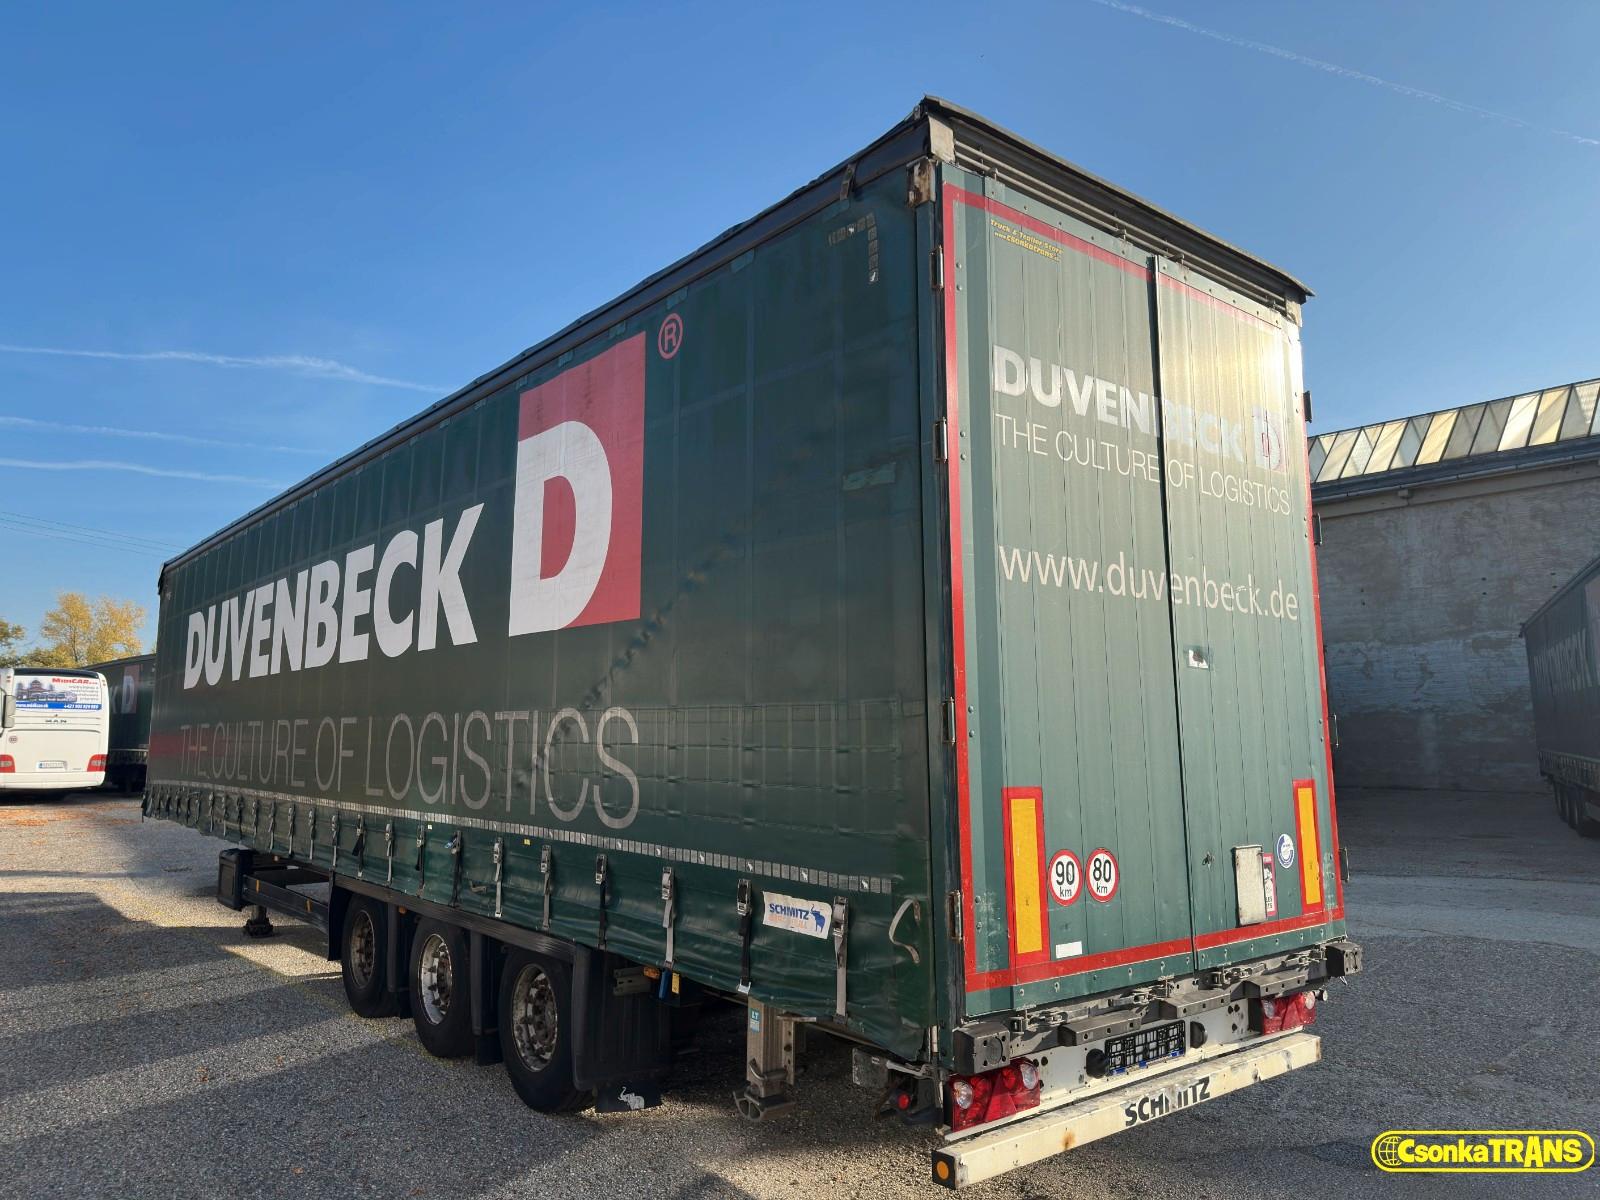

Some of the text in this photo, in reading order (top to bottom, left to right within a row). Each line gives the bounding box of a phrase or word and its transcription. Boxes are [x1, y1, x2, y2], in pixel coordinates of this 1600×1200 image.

[993, 345, 1245, 463] DUVENBECK
[995, 413, 1291, 516] THE CULTURE OF LOGISTICS
[184, 420, 613, 690] DUVENBECK D
[999, 546, 1298, 620] www.duvenbeck.de
[181, 706, 640, 829] THE CULTURE OF LOGISTICS
[1055, 860, 1075, 886] 90
[1060, 887, 1072, 897] km
[1093, 857, 1111, 883] 80
[1096, 882, 1108, 893] km
[769, 903, 810, 921] SCHMITZ
